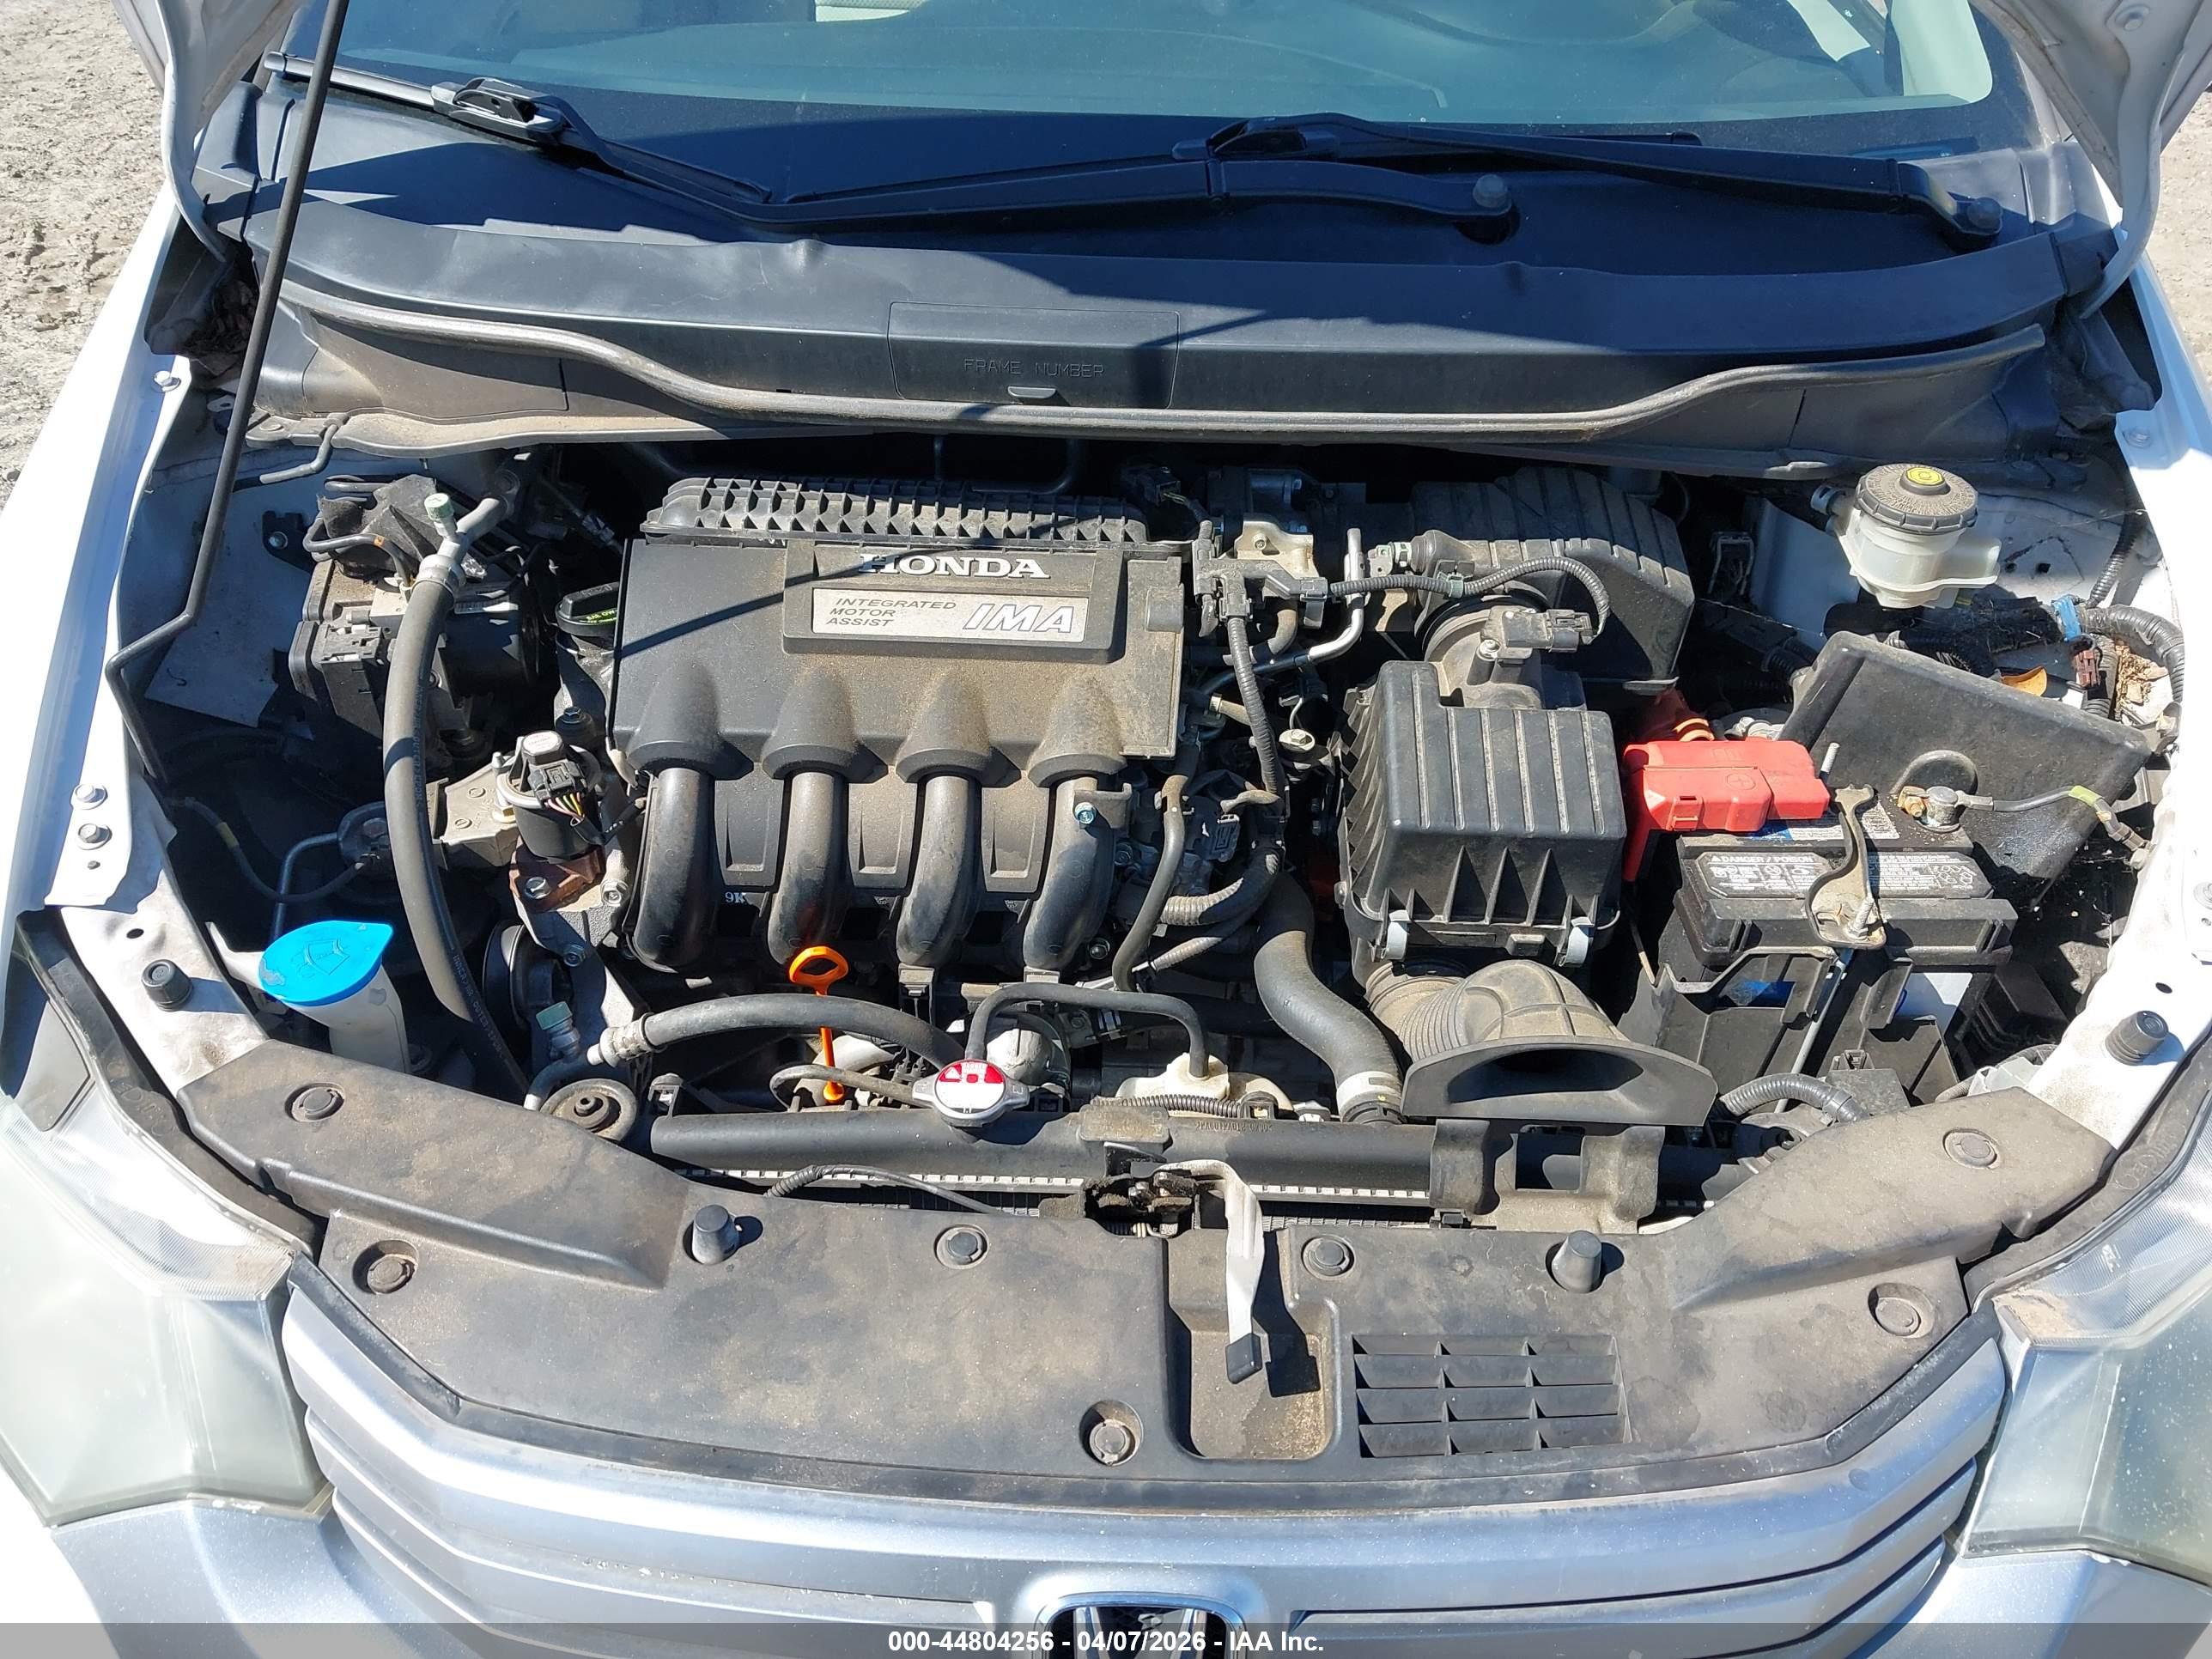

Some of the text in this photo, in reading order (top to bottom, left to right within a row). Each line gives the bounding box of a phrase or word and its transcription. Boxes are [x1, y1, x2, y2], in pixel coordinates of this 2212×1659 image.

[963, 358, 1105, 378] FRAME NUMBER
[859, 554, 1051, 580] HONDA
[830, 607, 896, 617] MOTOR
[836, 598, 957, 610] INTEGRATED
[826, 617, 894, 627] ASSIST
[963, 603, 1074, 634] IMA
